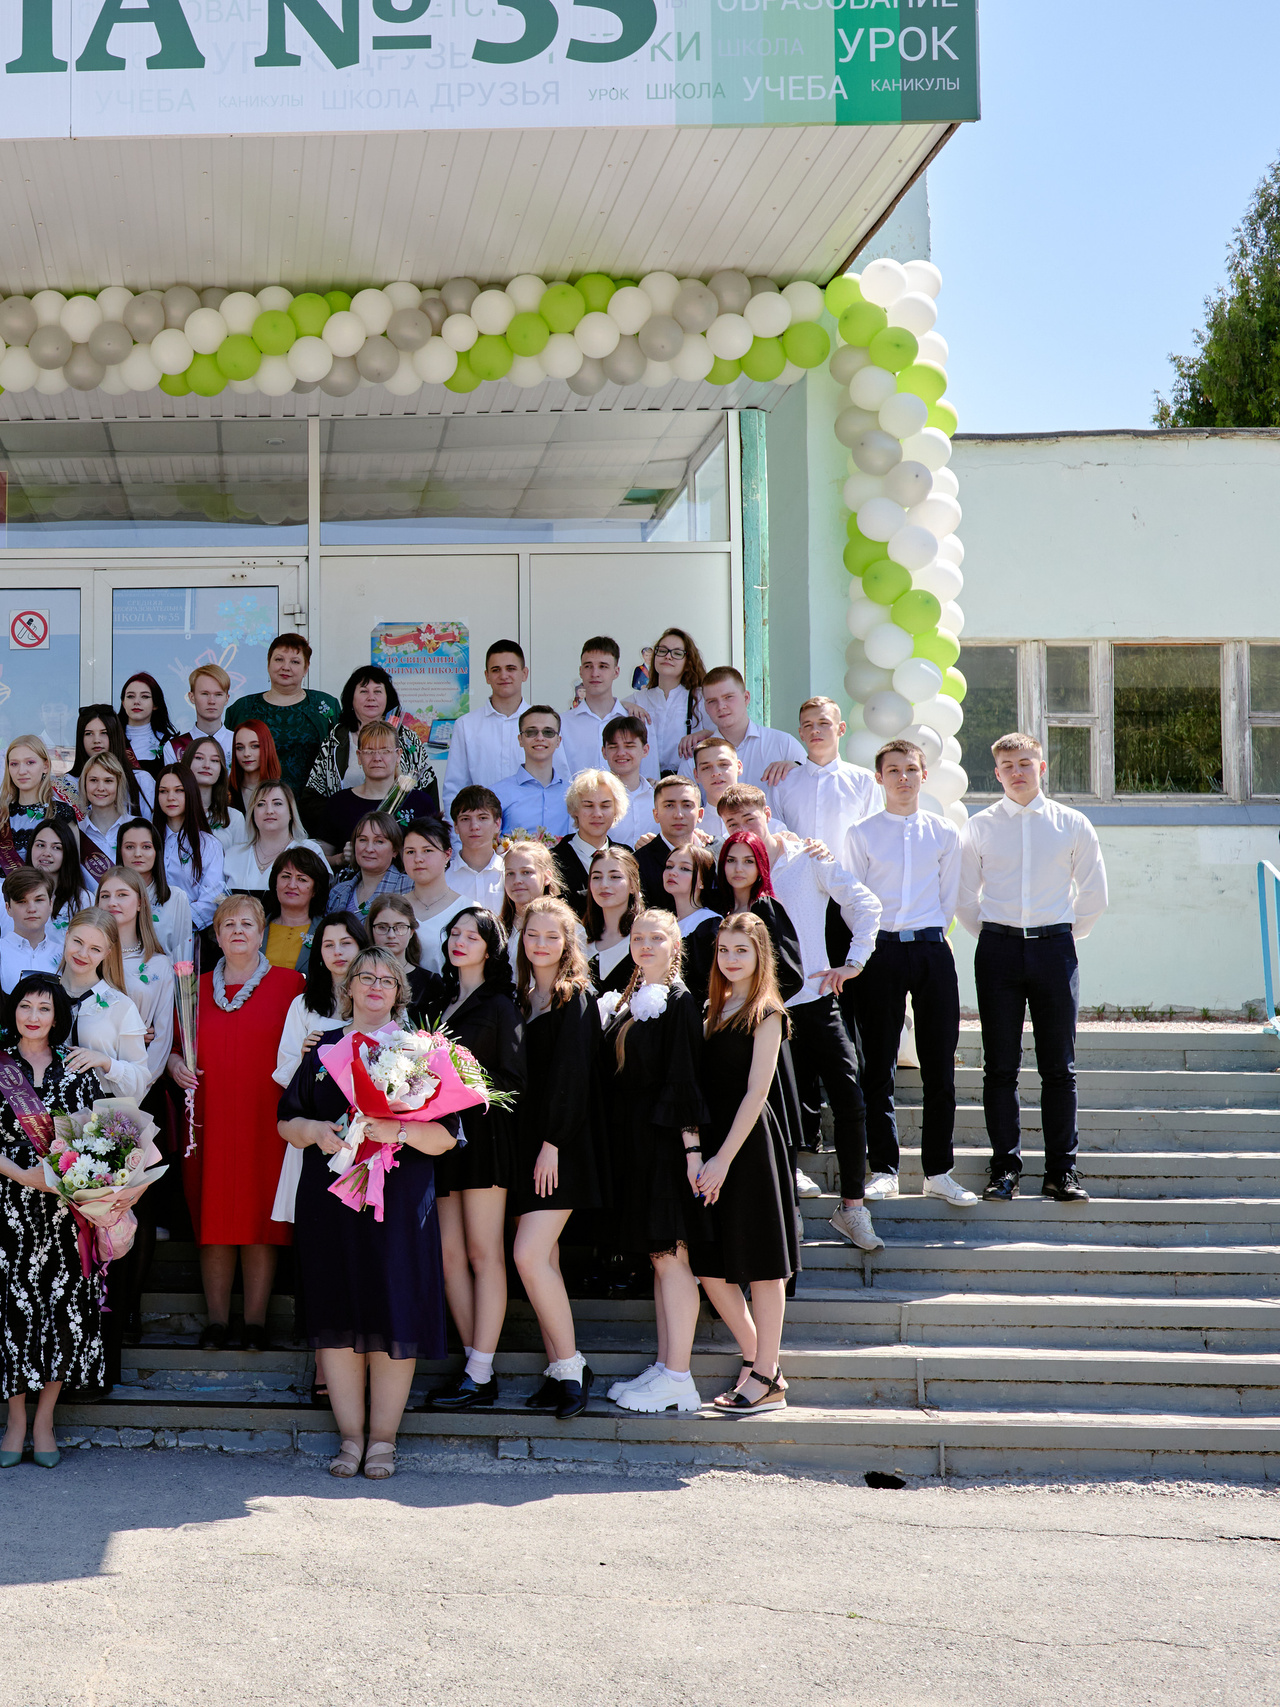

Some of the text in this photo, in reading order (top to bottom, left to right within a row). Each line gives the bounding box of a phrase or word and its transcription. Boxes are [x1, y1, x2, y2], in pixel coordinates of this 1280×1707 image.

[717, 37, 805, 57] ШКОЛА
[837, 25, 960, 63] УРОК
[95, 74, 960, 115] УЧЕБА КАНИКУЛЫ ШКОЛА ДРУЗЬЯ УРОК ШКОЛА УЧЕБА КАНИКУЛЫ
[384, 655, 458, 666] ДО СВИДАНИЯ,
[427, 666, 469, 676] ШКОЛА!
